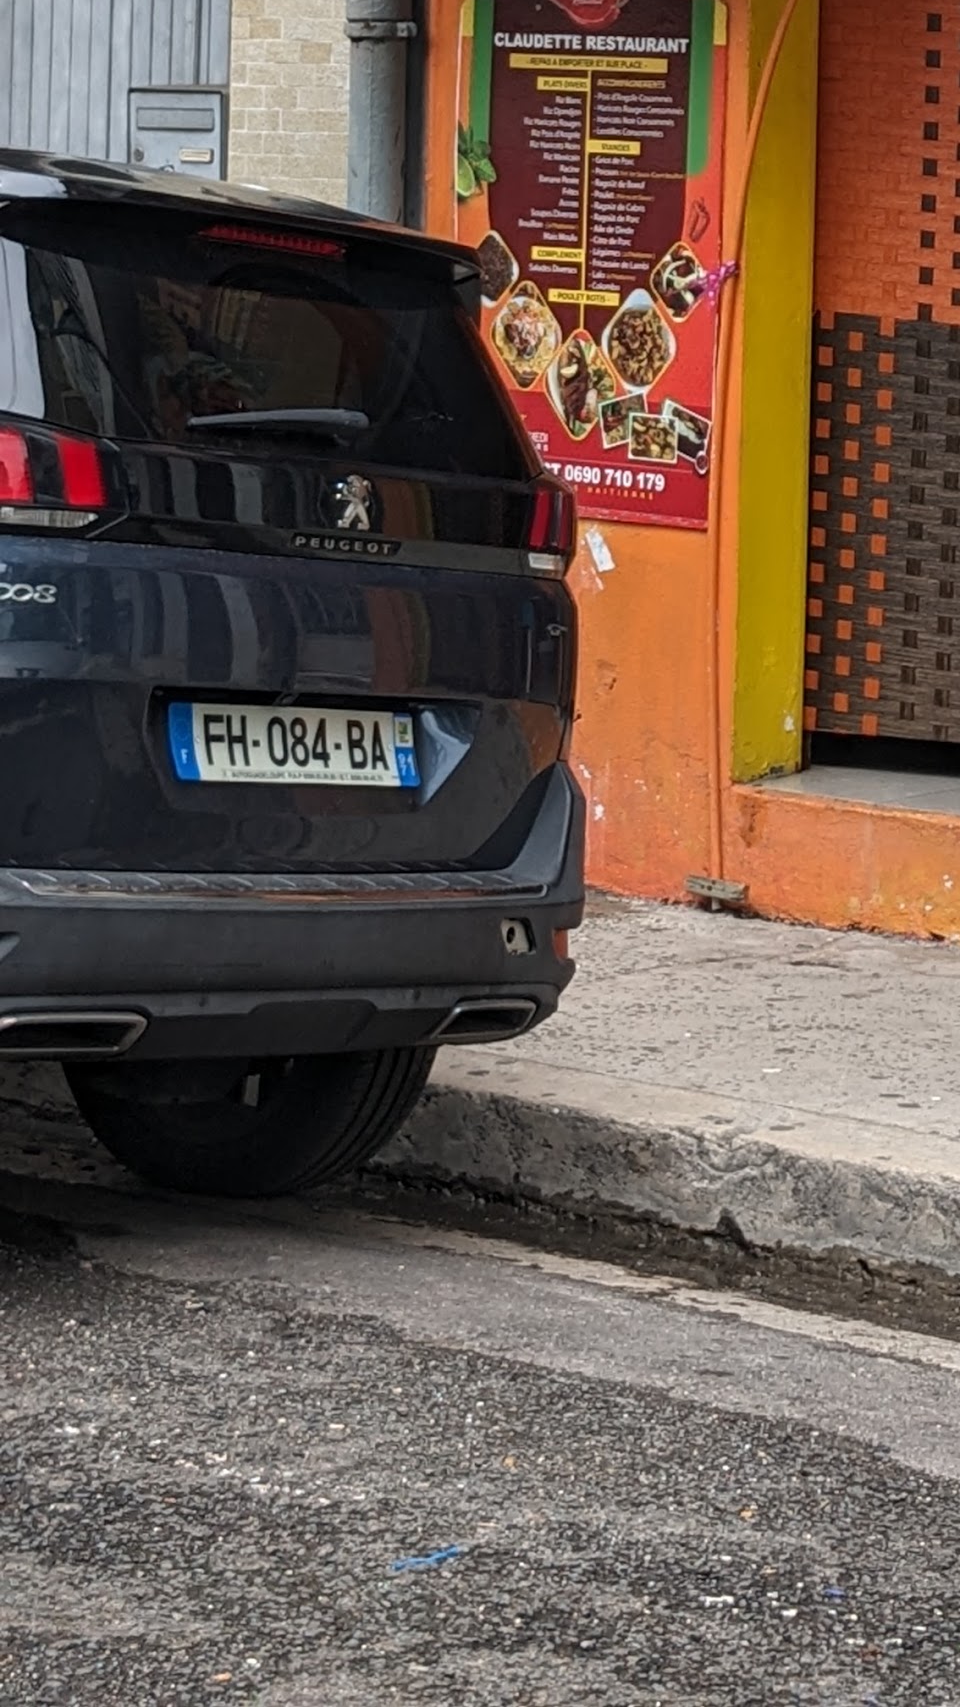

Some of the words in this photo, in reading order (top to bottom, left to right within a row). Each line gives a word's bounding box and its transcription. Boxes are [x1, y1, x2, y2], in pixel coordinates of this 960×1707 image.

[494, 32, 582, 50] CLAUDETTE
[585, 35, 690, 54] RESTAURANT
[564, 464, 601, 484] 0690
[604, 469, 632, 487] 710
[636, 473, 665, 492] 179
[294, 536, 391, 555] PEUGEOT
[203, 714, 390, 771] FH-084-BA
